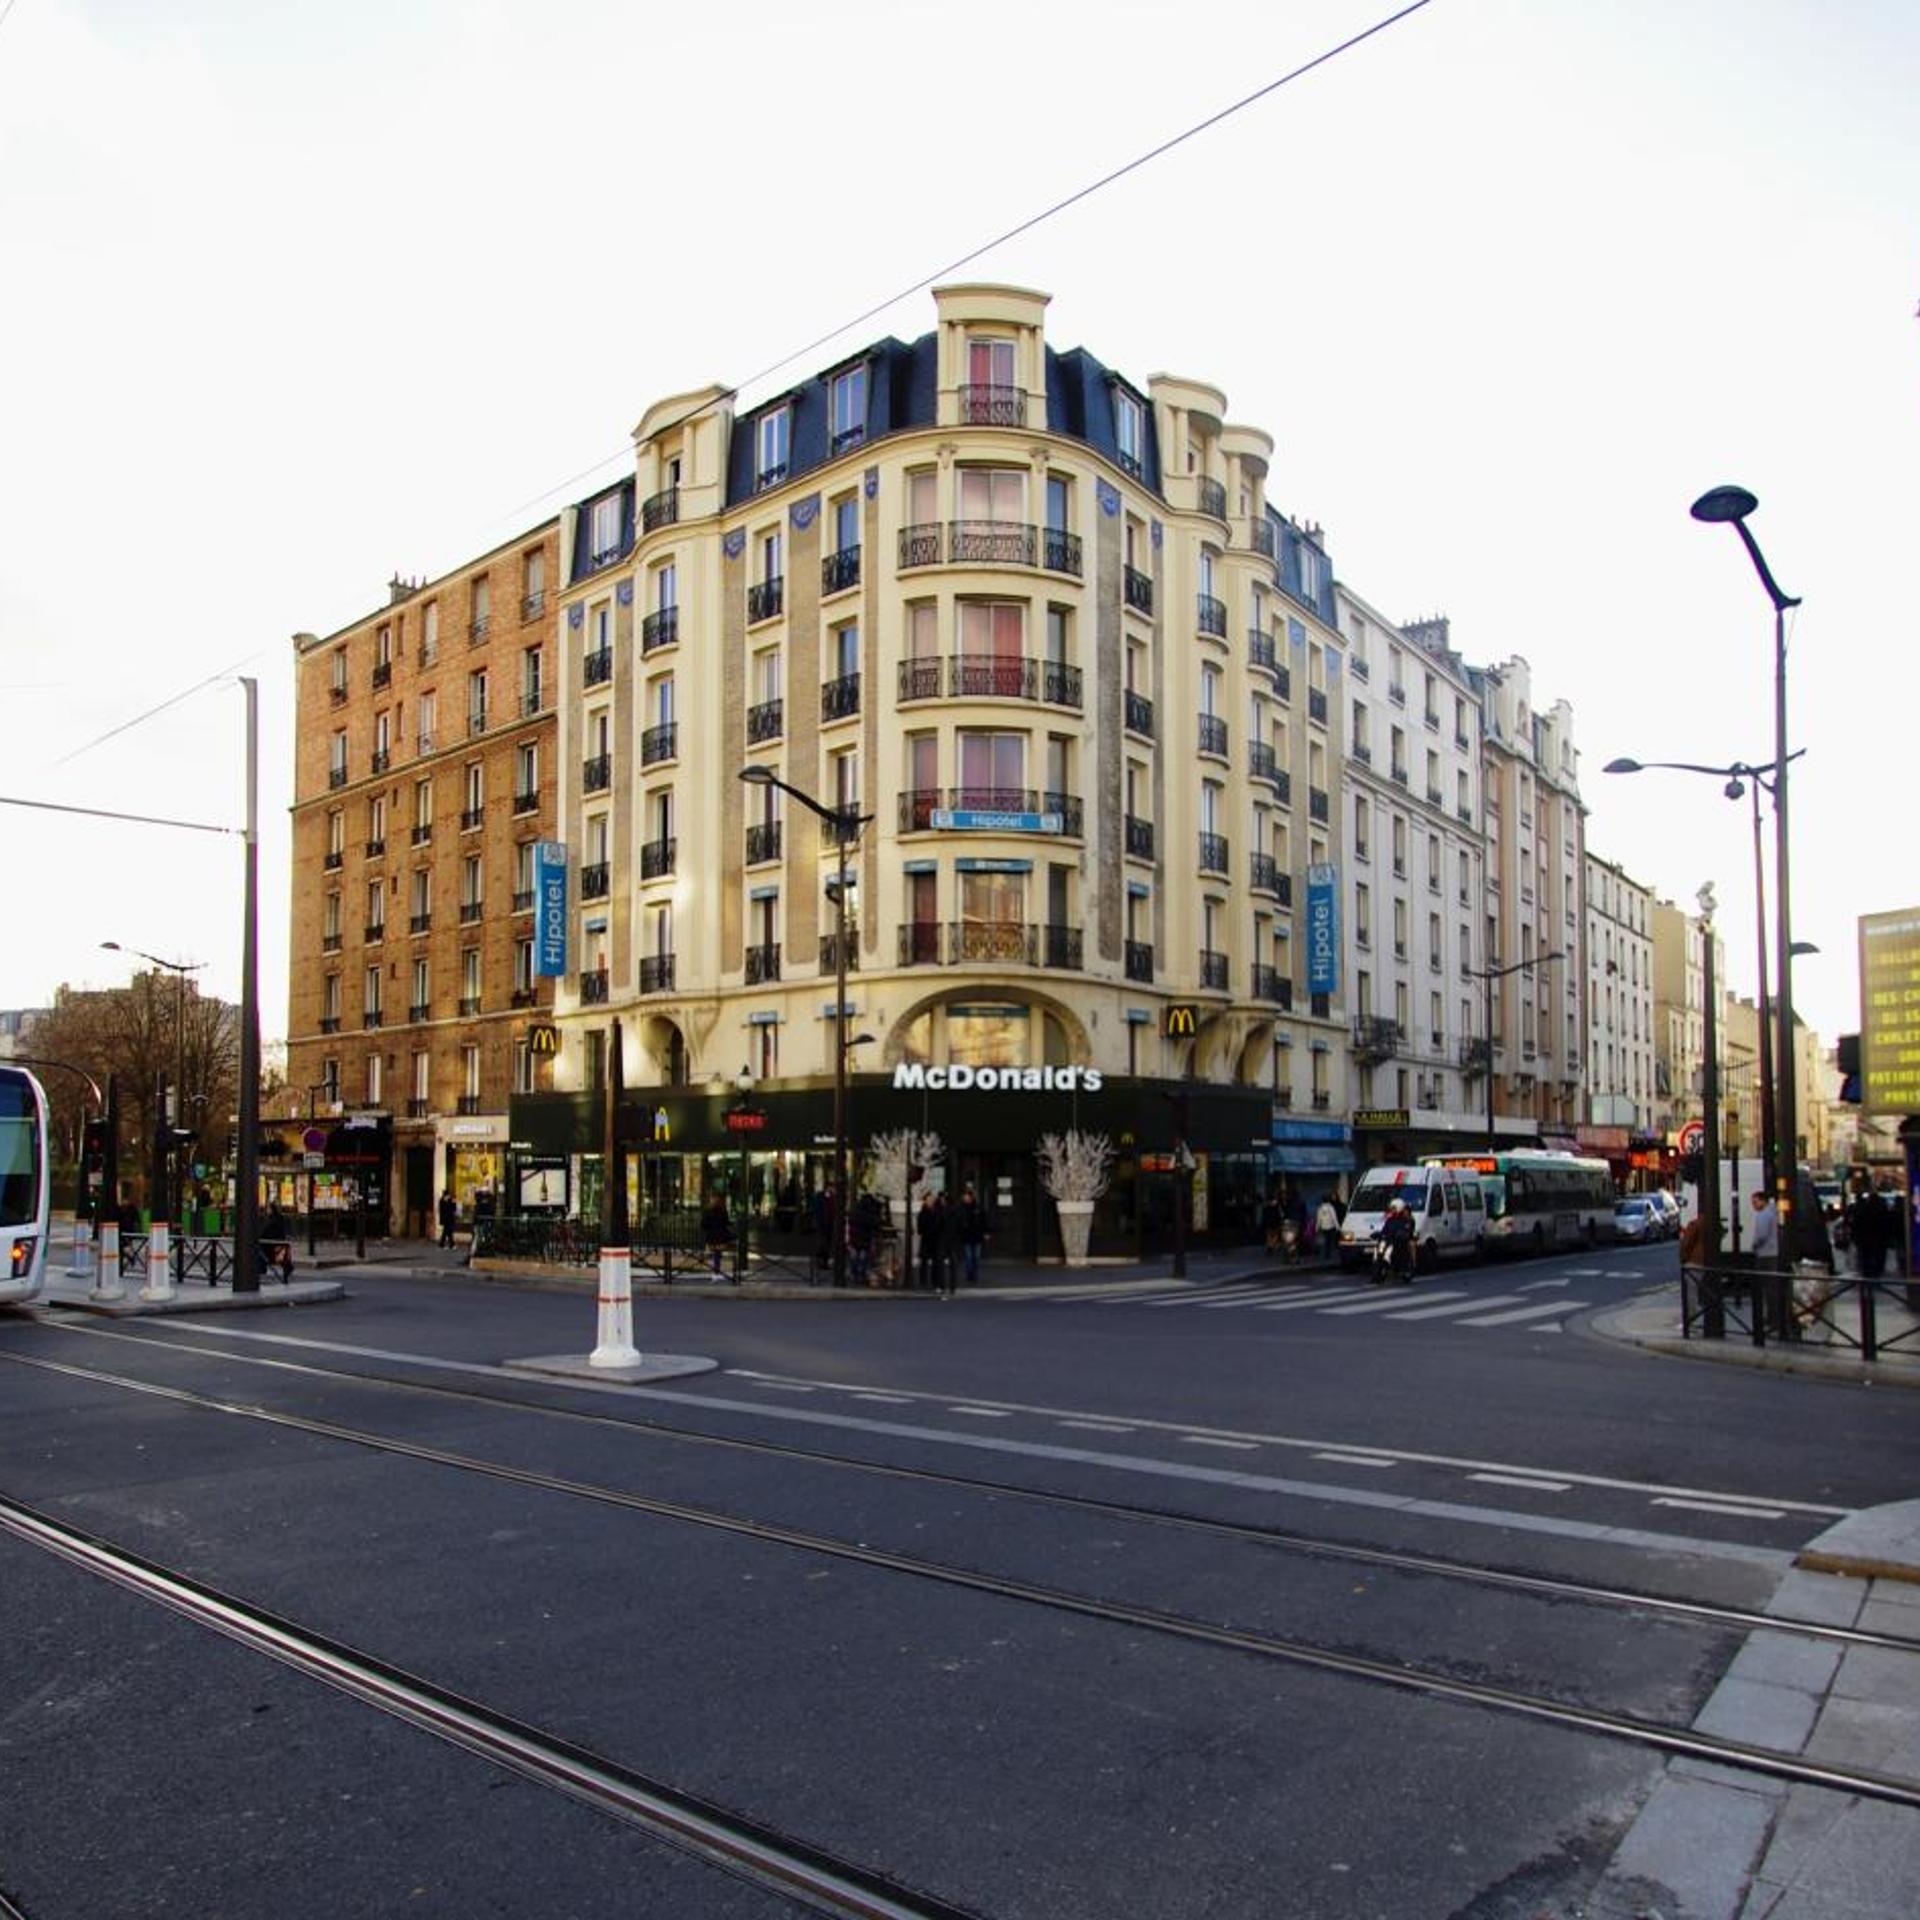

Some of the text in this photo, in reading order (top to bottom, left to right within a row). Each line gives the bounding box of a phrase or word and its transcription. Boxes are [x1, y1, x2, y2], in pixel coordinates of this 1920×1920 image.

[545, 878, 564, 964] Hipotel
[1311, 897, 1332, 981] Hipotel
[893, 1063, 1102, 1091] McDonald's
